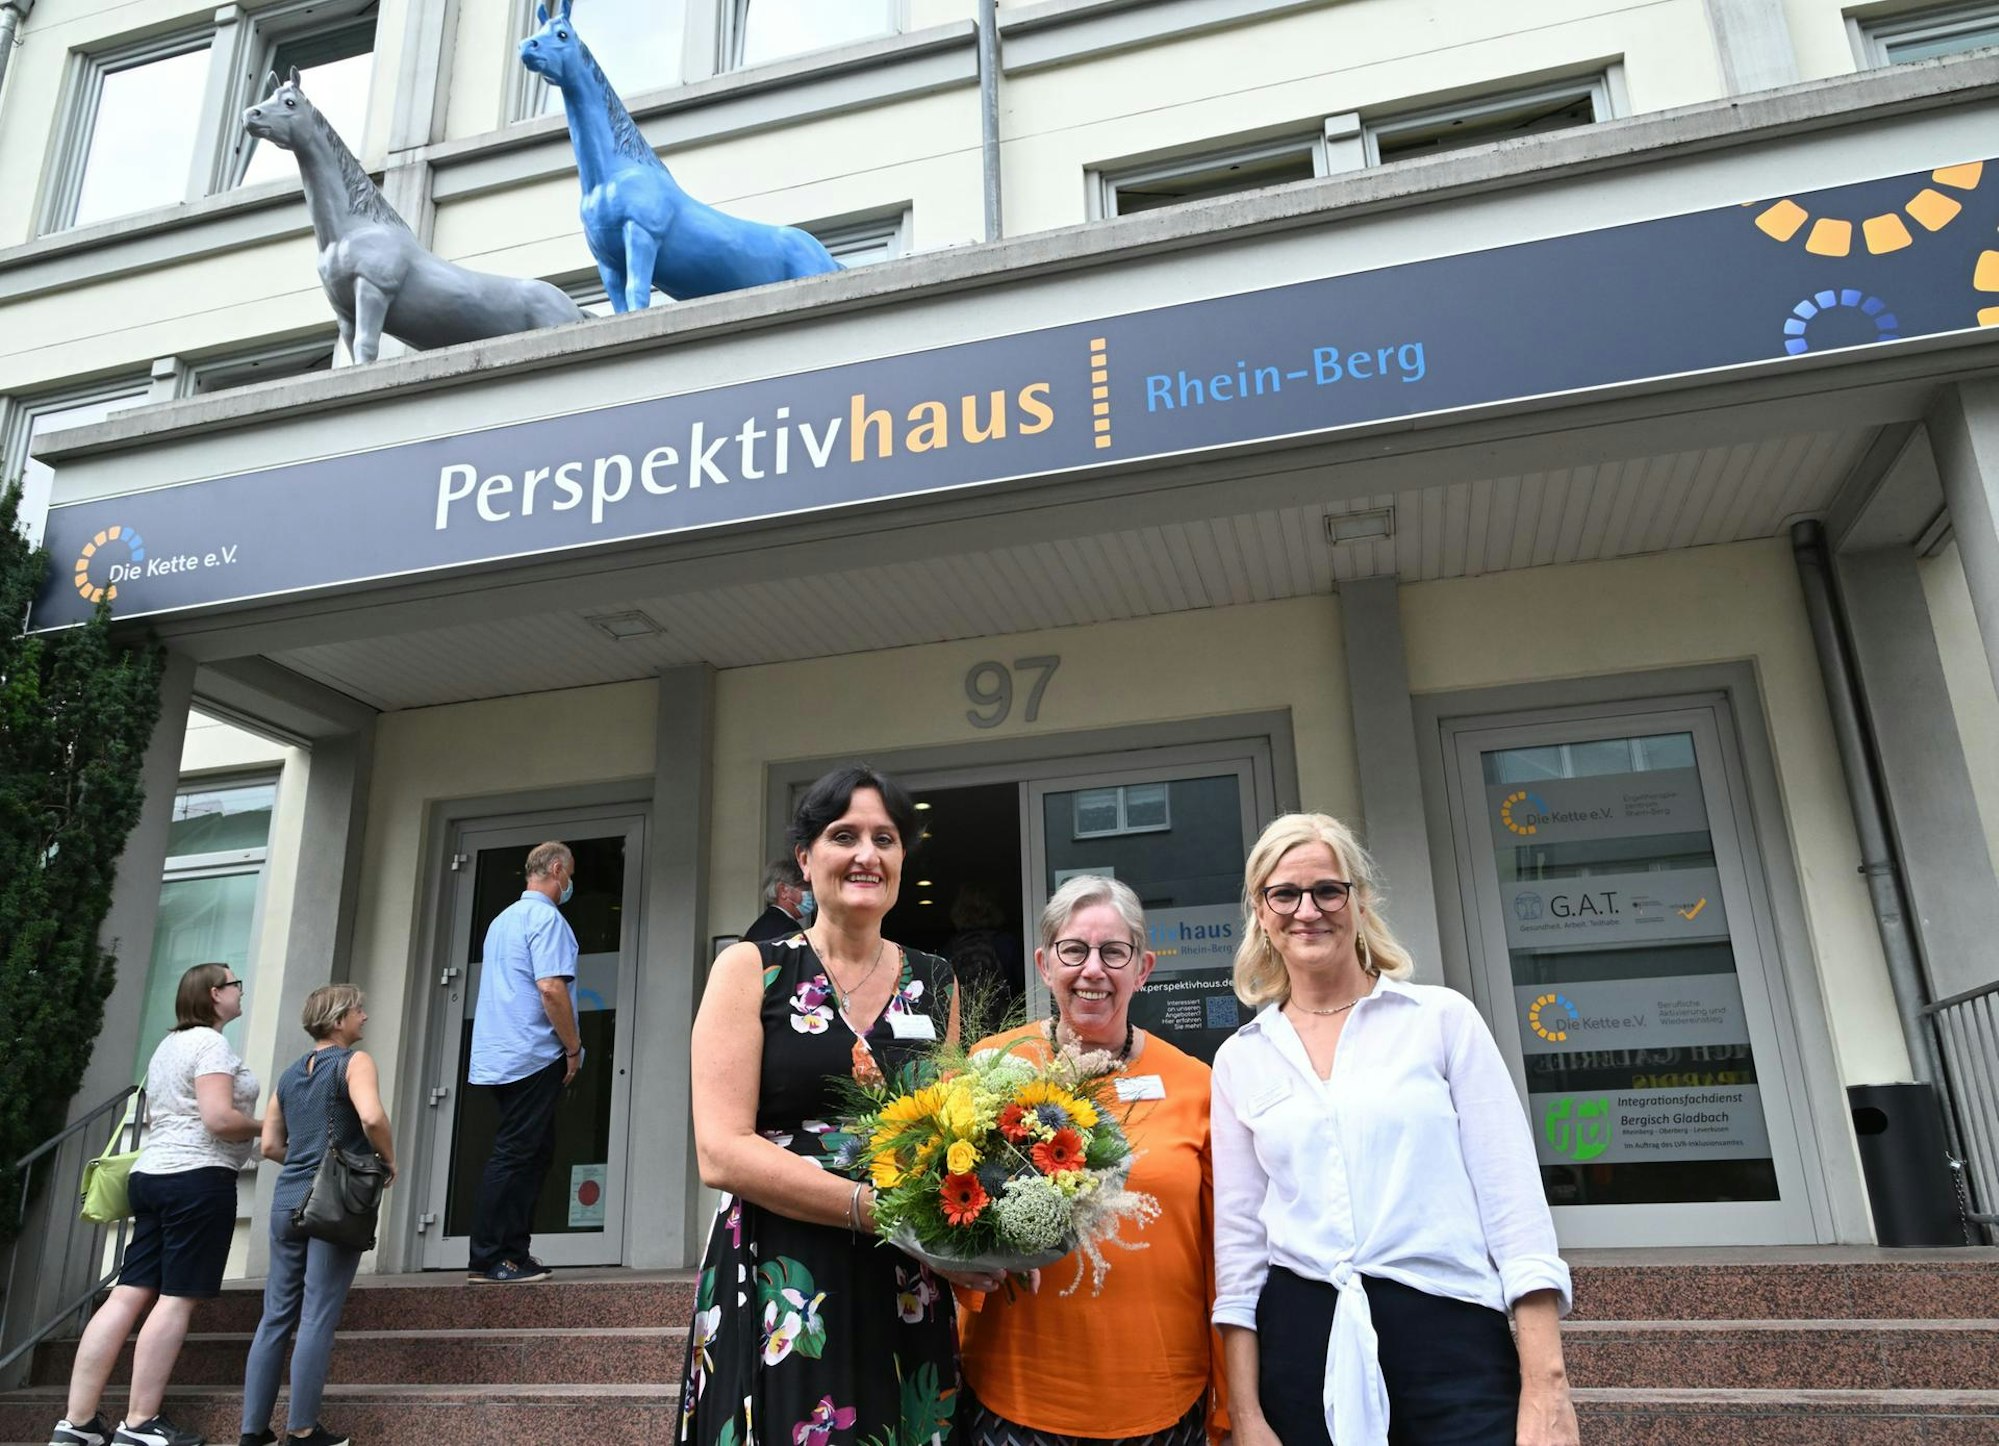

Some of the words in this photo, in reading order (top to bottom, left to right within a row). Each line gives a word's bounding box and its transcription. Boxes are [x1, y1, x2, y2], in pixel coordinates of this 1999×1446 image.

[1146, 342, 1426, 412] Rhein-Berg
[435, 382, 1055, 531] Perspektivhaus
[109, 563, 141, 583] Die
[147, 554, 198, 577] Kette
[204, 544, 238, 567] e.V.
[965, 655, 1061, 729] 97
[1527, 813, 1549, 826] Die
[1552, 810, 1587, 823] Kette
[1590, 807, 1613, 821] e.V.
[1551, 892, 1619, 918] G.A.T.
[1181, 943, 1233, 956] Rhein-Berg
[1659, 1008, 1707, 1018] Aktivierung
[1709, 1006, 1726, 1014] und
[1556, 1018, 1580, 1031] Die
[1583, 1016, 1620, 1030] Kette
[1623, 1015, 1647, 1028] e.V.
[1617, 1092, 1743, 1108] Integrationsfachdienst
[1621, 1114, 1670, 1127] Bergisch
[1673, 1112, 1729, 1124] Gladbach
[1635, 1142, 1660, 1150] Auftrag
